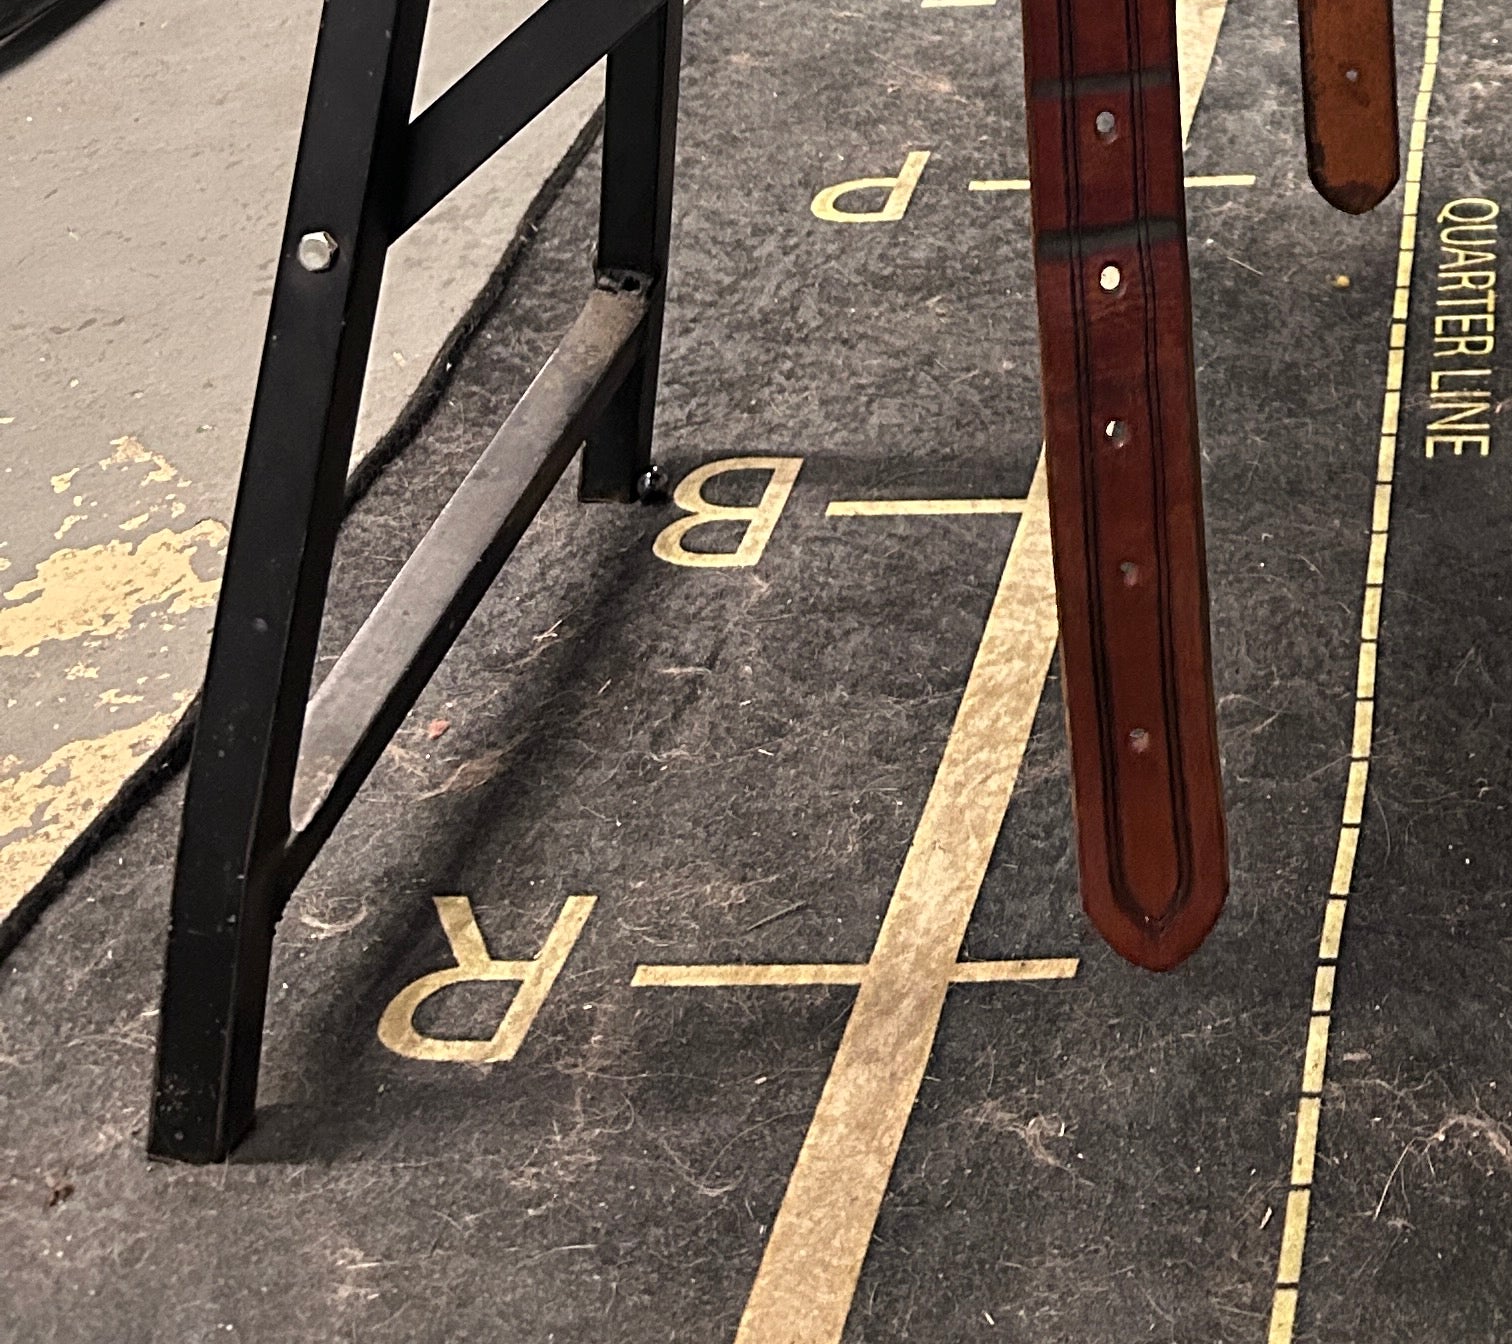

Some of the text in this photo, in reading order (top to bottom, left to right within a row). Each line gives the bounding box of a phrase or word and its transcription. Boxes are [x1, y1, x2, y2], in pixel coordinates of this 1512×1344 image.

[810, 151, 931, 223] P
[1425, 197, 1500, 459] QUARTER LINE
[651, 456, 804, 568] B
[377, 895, 598, 1062] R
